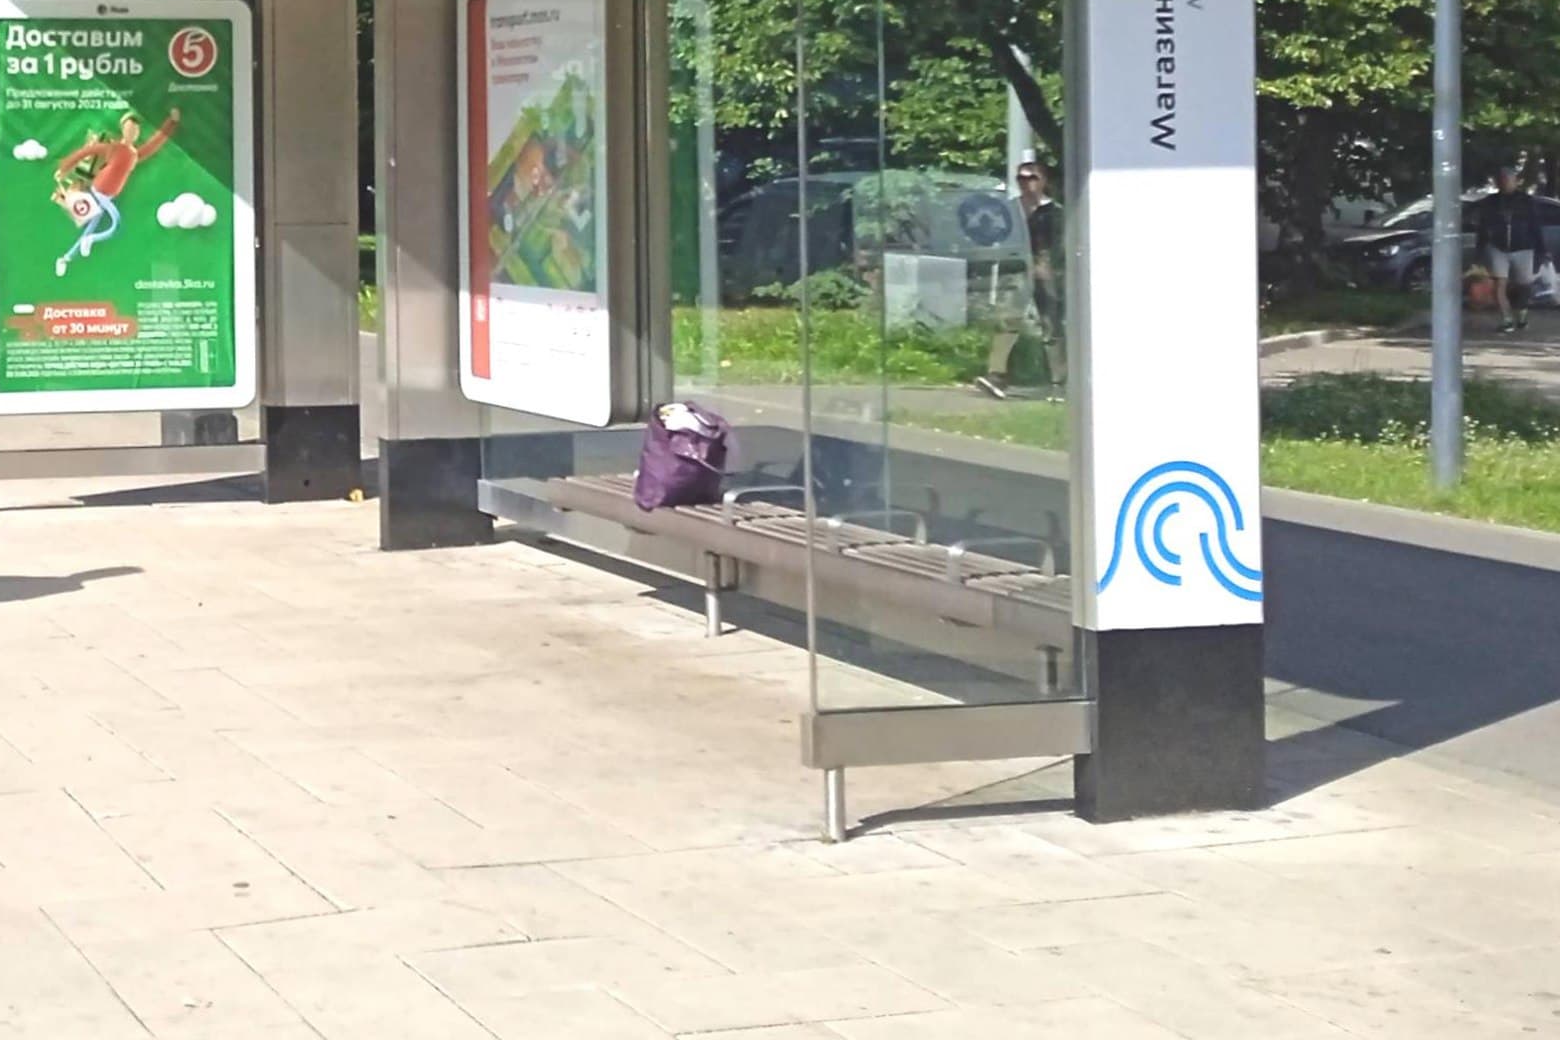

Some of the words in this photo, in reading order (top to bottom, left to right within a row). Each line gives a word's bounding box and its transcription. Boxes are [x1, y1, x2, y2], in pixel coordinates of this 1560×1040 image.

[6, 24, 143, 50] Доставим
[6, 56, 39, 75] за
[43, 53, 54, 75] 1
[60, 53, 143, 80] рубль
[43, 306, 107, 319] Доставка
[52, 324, 67, 335] от
[70, 322, 84, 334] 30
[86, 324, 129, 336] минут
